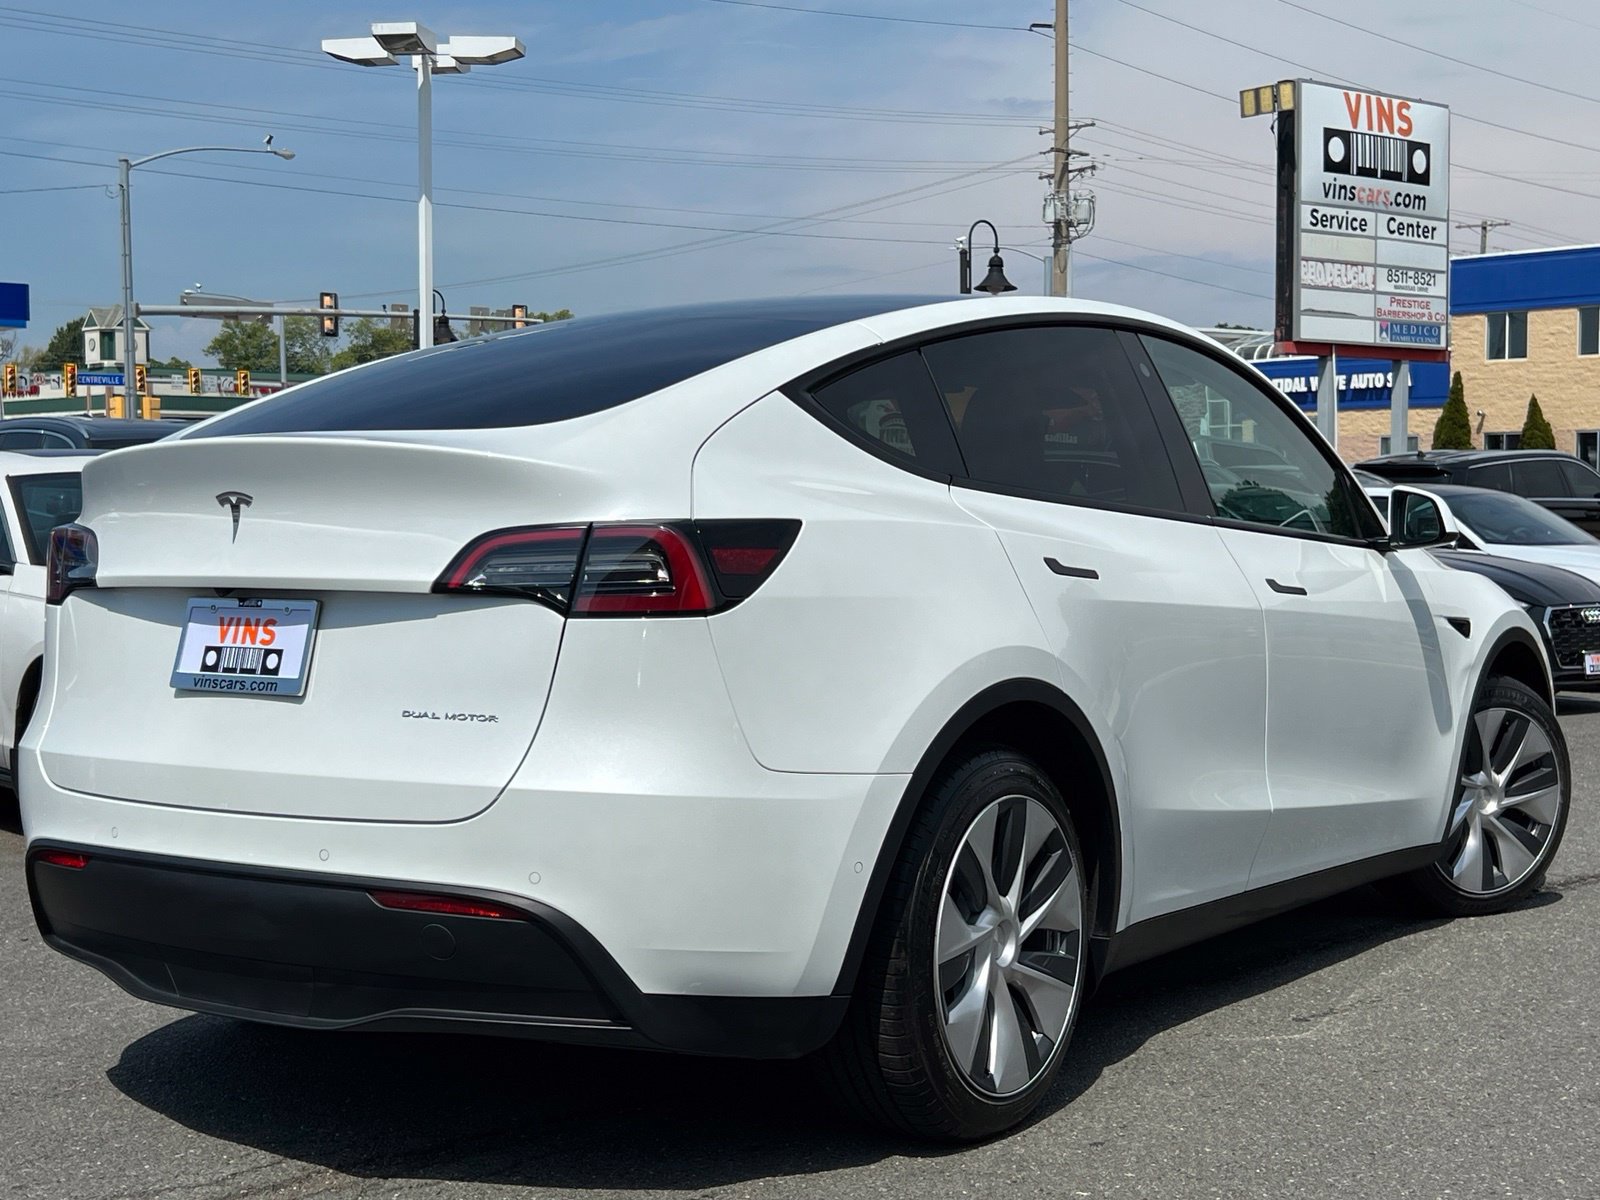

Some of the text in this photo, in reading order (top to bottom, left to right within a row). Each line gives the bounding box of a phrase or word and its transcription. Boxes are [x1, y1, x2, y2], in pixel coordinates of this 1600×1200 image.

[1343, 91, 1414, 137] VINS
[1322, 177, 1427, 211] vinscars.com
[1309, 207, 1437, 240] Service Center
[1387, 269, 1436, 287] 8511-8521
[1392, 324, 1439, 336] MEDICO
[1392, 335, 1415, 343] FAMILY
[1416, 336, 1439, 344] CLINIC
[77, 376, 120, 385] CENTREVILLE
[1350, 372, 1385, 389] AUTO
[217, 615, 279, 646] VINS
[192, 674, 278, 692] vinscars.com
[401, 709, 499, 723] DUAL MOTOR
